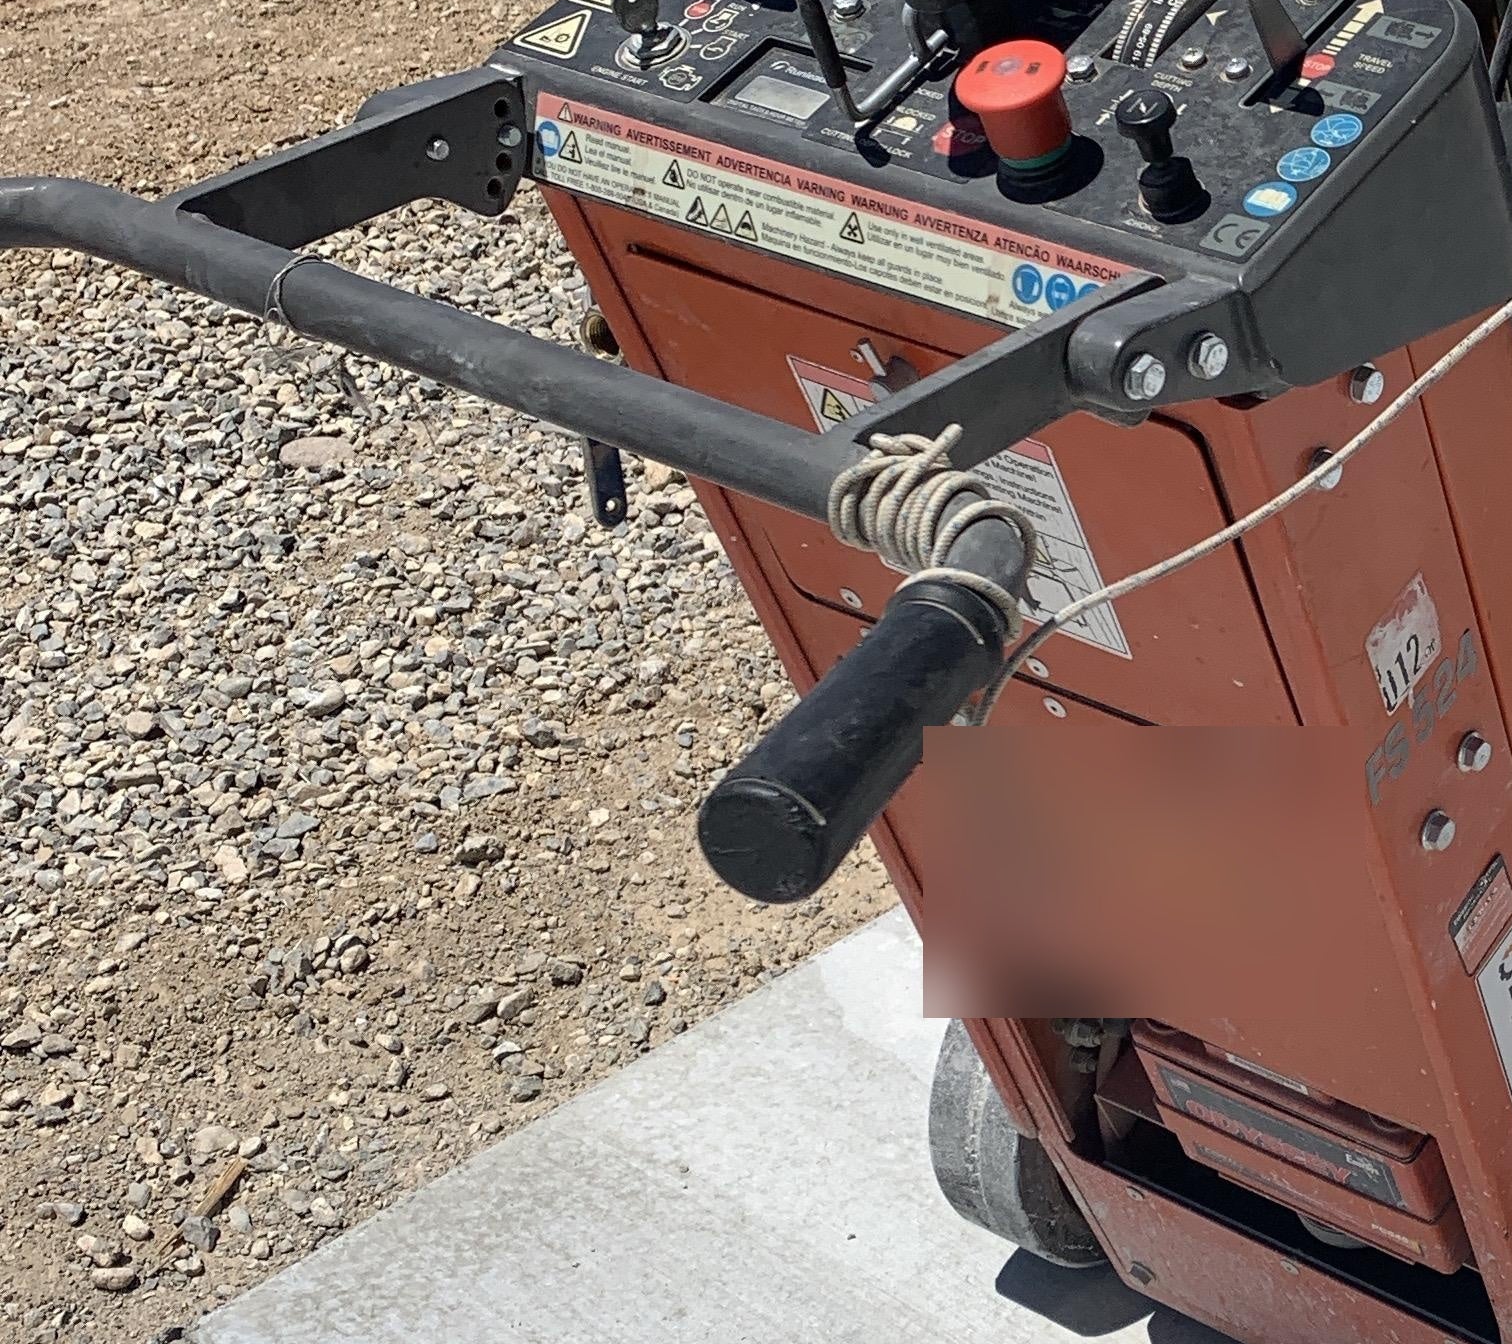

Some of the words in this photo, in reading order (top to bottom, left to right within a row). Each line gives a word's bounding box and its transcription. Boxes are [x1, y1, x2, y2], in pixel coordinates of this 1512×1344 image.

[1303, 60, 1332, 72] STOP
[1353, 61, 1386, 74] SPEED
[1358, 53, 1393, 69] TRAVEL
[622, 74, 649, 86] START
[1151, 78, 1184, 93] DEPTH
[1154, 71, 1193, 87] CUTTING
[585, 133, 603, 146] Read
[605, 140, 630, 154] manual.
[944, 128, 985, 145] STOP
[585, 144, 597, 155] Lea
[551, 172, 564, 182] TOLL
[566, 176, 583, 188] FREE
[557, 165, 566, 173] DO
[568, 168, 581, 178] NOT
[583, 172, 601, 183] HAVE
[603, 178, 610, 186] AN
[573, 113, 621, 136] WARNING
[626, 129, 711, 162] AVERTISSEMENT
[716, 154, 791, 187] ADVERTENCIA
[797, 178, 844, 202] VARNING
[850, 194, 908, 221] WARNUNG
[914, 212, 988, 244] AVVERTENZA
[686, 168, 698, 180] DO
[700, 172, 716, 185] NOT
[718, 178, 743, 194] operate
[745, 187, 761, 198] near
[762, 191, 804, 211] combustible
[686, 179, 696, 189] No
[766, 203, 783, 217] lugar
[761, 221, 796, 241] Machinery
[799, 233, 825, 248] Hazard
[831, 243, 855, 259] Always
[887, 260, 911, 276] guards
[867, 222, 881, 233] Use
[883, 227, 898, 240] only
[909, 234, 923, 246] well
[925, 239, 960, 257] ventilated
[915, 247, 933, 261] lugar
[935, 254, 951, 266] muy
[953, 258, 969, 270] bien
[1366, 721, 1410, 807] FS
[1412, 627, 1479, 744] 524
